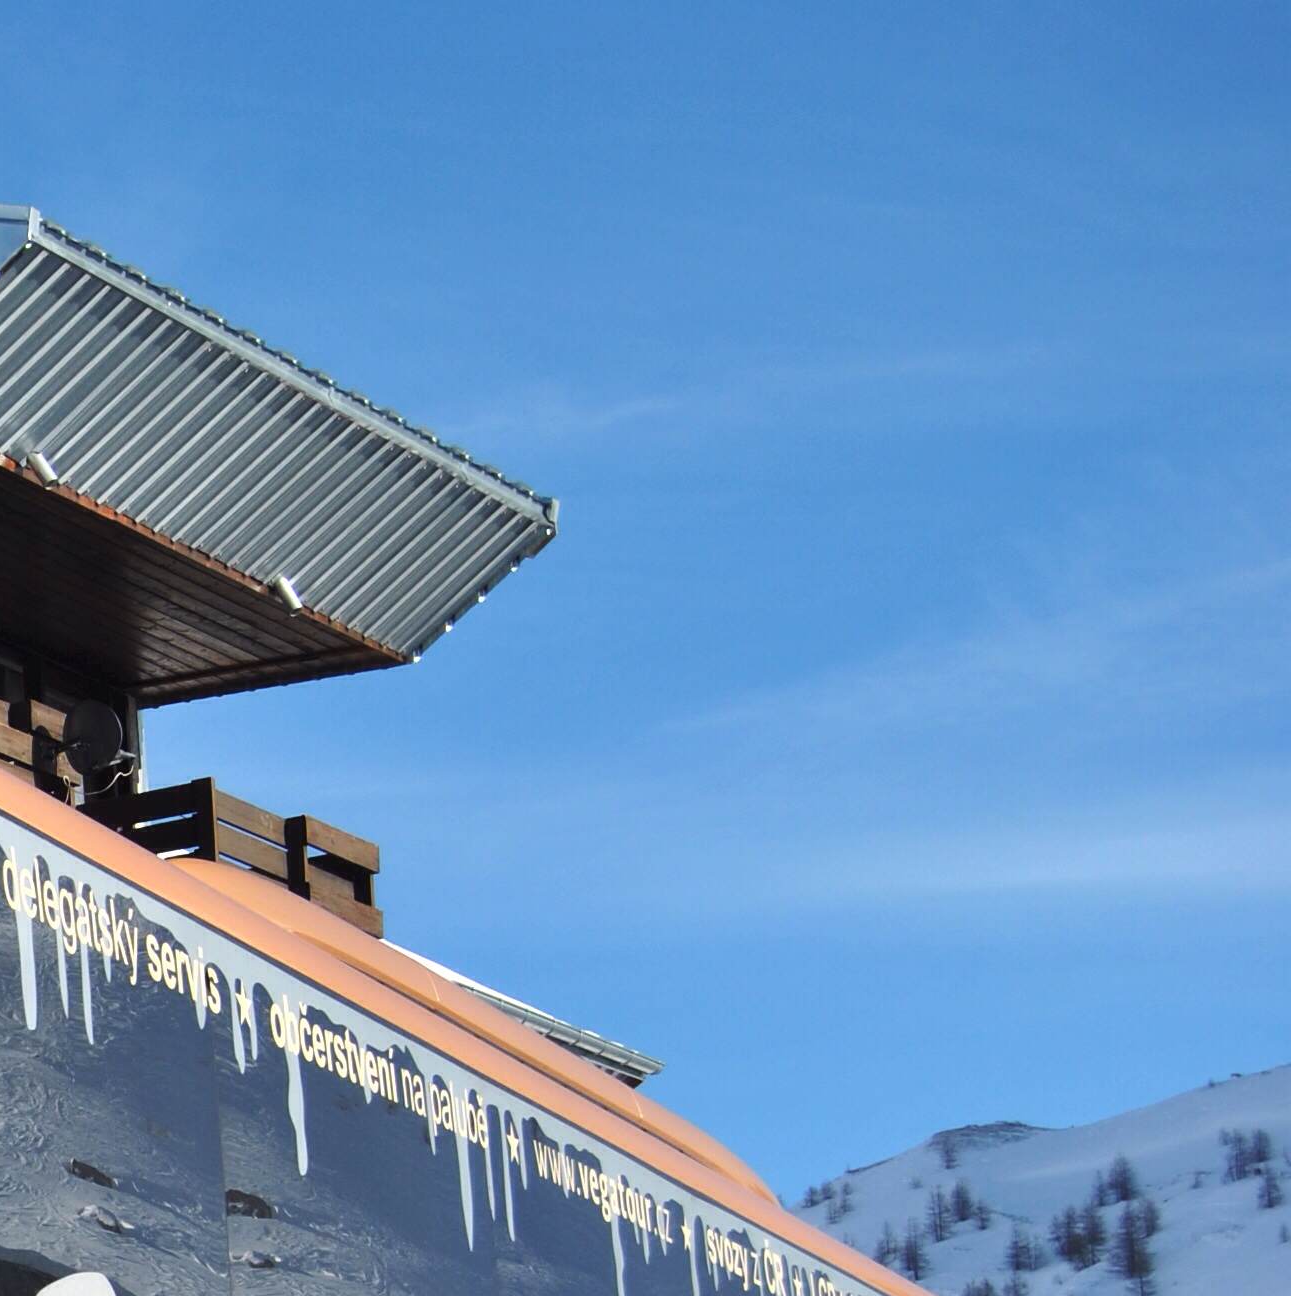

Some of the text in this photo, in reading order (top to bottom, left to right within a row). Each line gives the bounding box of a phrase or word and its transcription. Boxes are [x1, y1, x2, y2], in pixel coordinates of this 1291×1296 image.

[2, 845, 221, 1015] delegátský servis
[270, 994, 489, 1149] občerstvení na palubě
[533, 1139, 673, 1244] www.vegatour.cz
[706, 1228, 749, 1291] svozy
[750, 1251, 762, 1287] z
